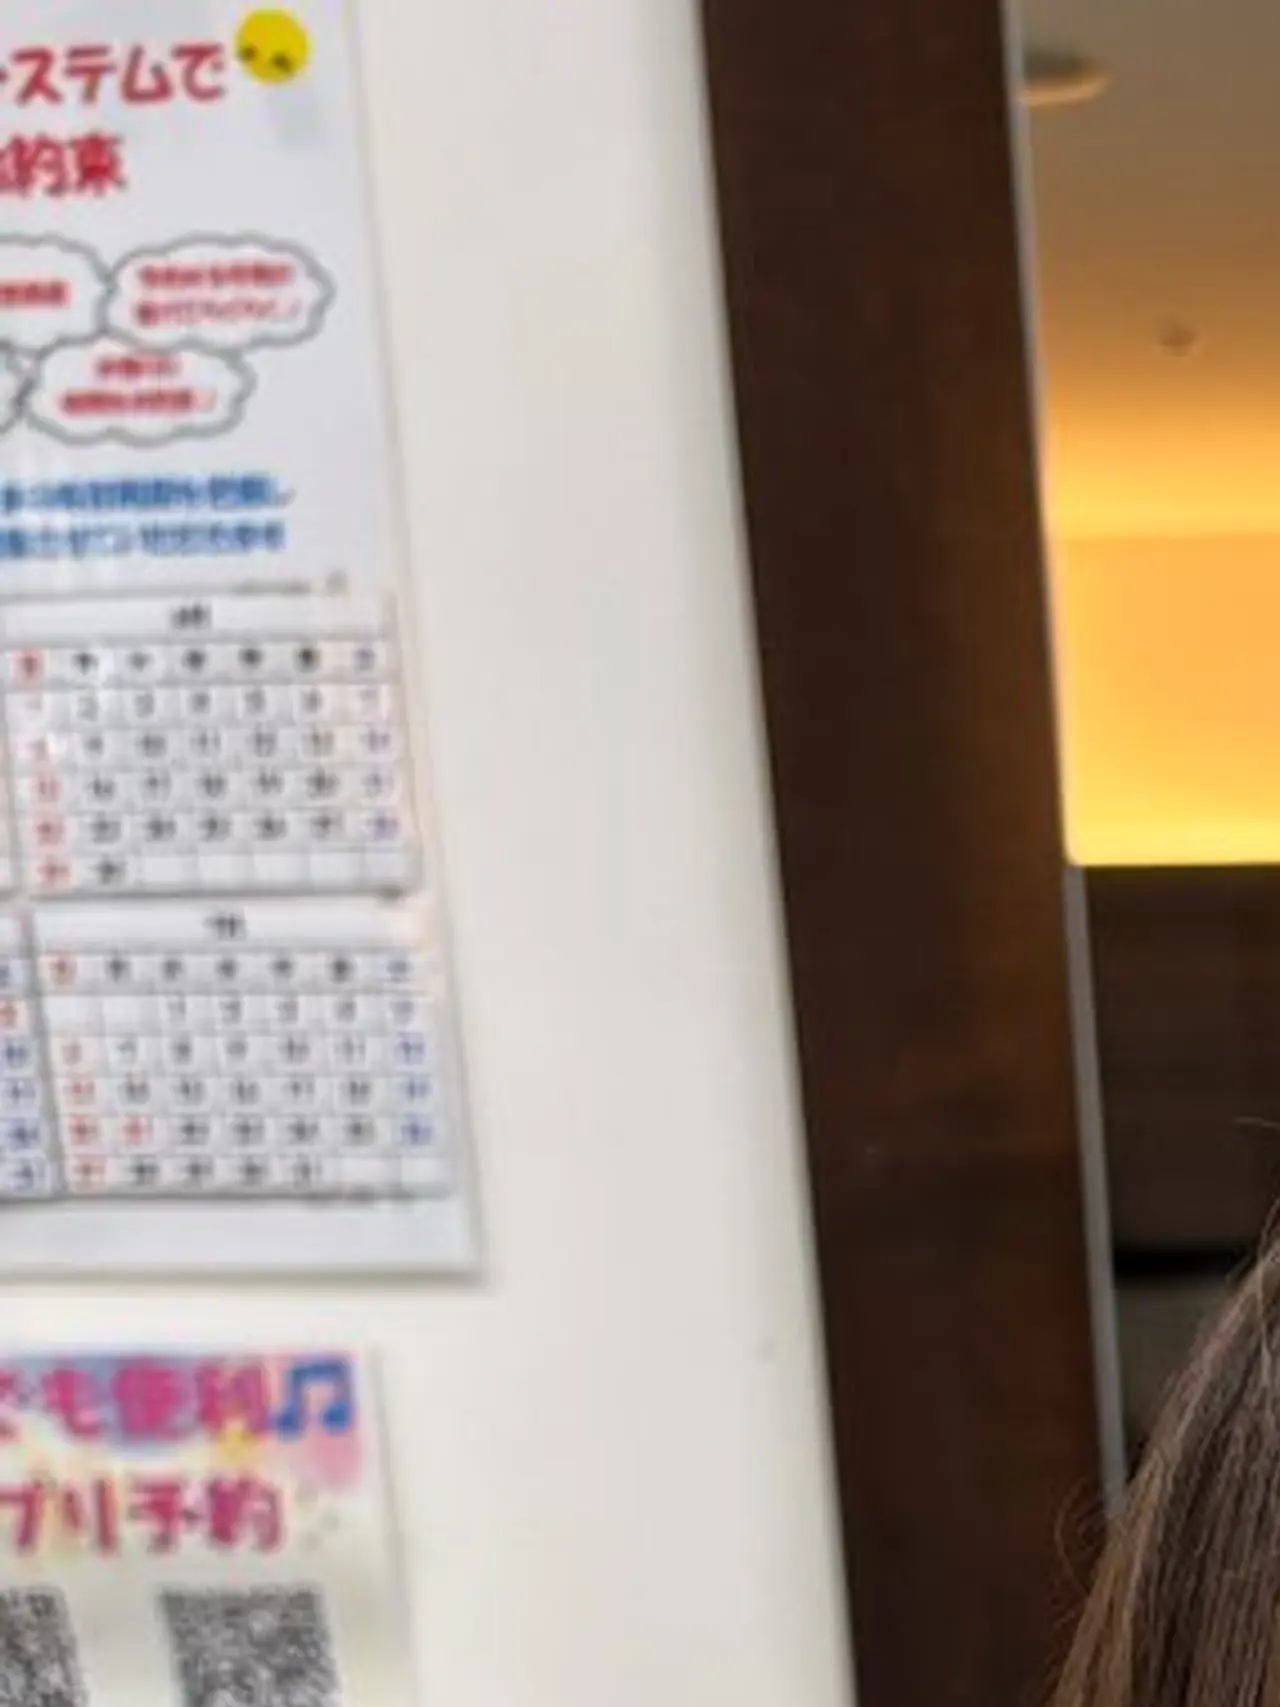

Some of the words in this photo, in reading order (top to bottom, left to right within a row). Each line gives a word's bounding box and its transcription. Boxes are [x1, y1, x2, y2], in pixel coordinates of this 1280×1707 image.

[0, 42, 226, 106] ステムで
[0, 132, 128, 198] 約束
